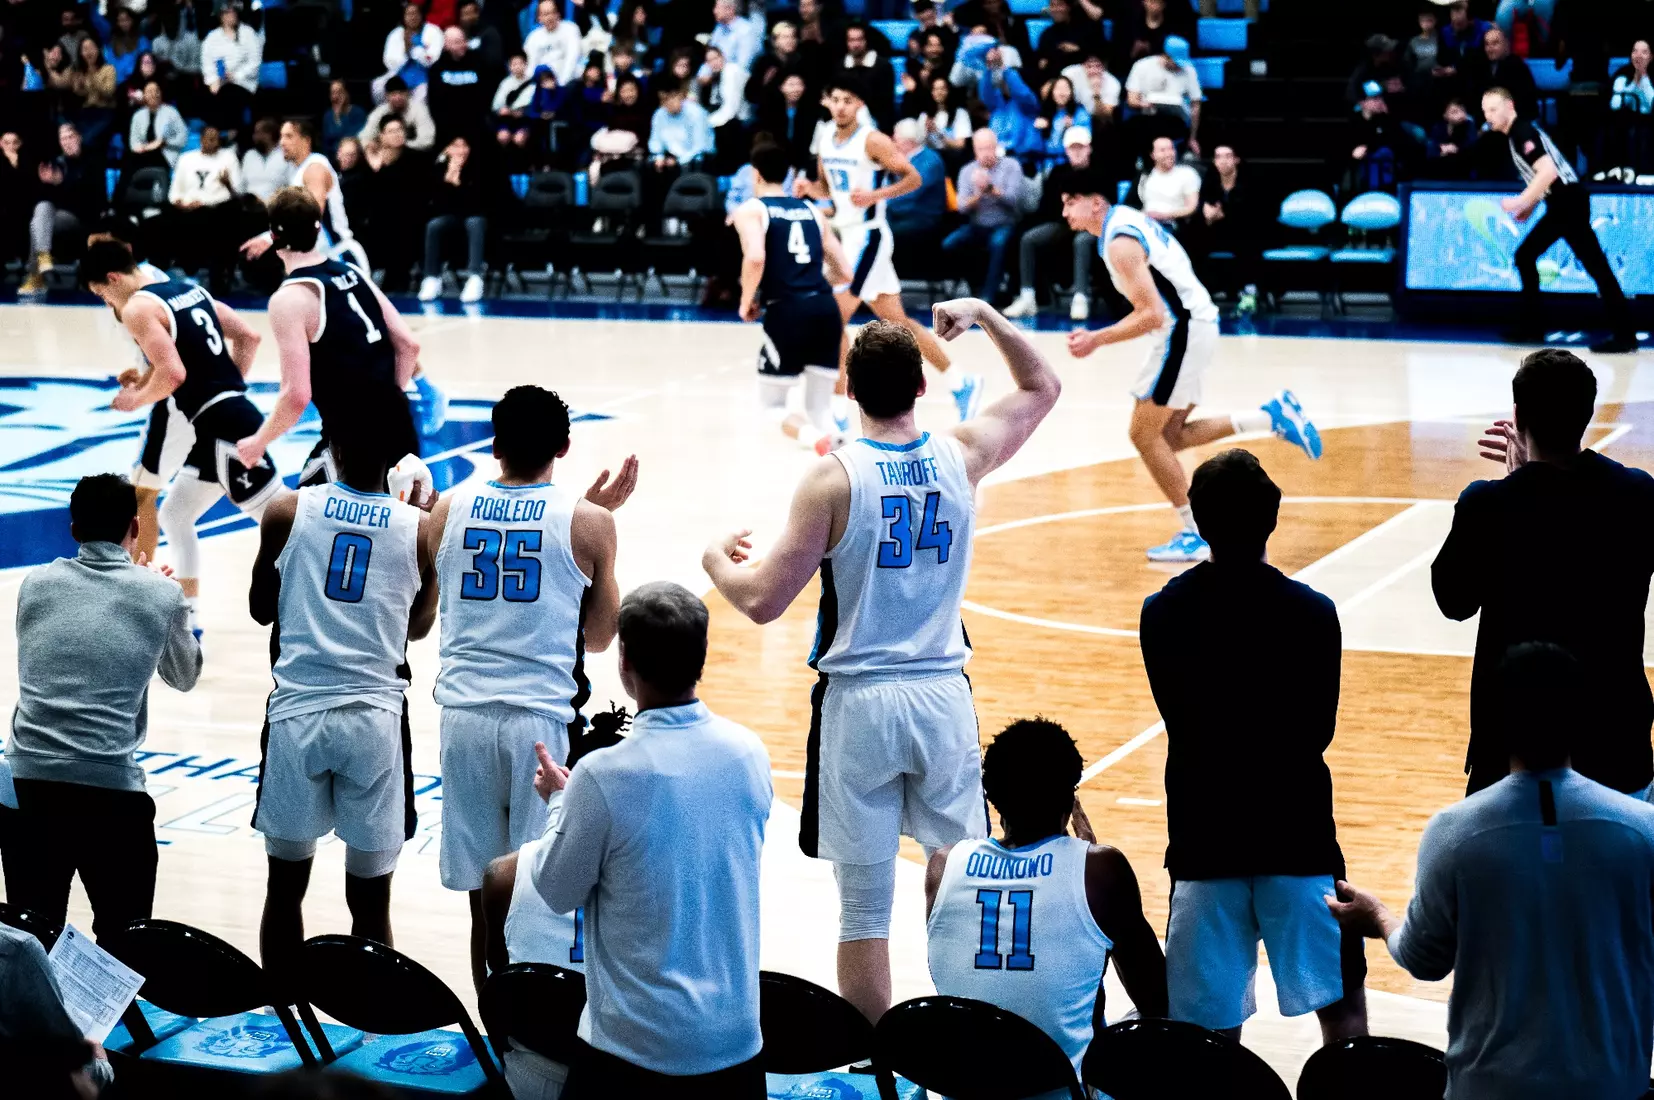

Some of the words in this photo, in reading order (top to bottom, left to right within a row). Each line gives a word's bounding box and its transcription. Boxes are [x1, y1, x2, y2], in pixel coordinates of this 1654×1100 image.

[196, 171, 210, 189] Y
[787, 220, 812, 264] 4
[190, 307, 223, 356] 3
[347, 292, 382, 344] 1
[324, 496, 391, 528] COOPER
[470, 495, 546, 522] ROBLEDO
[877, 491, 952, 568] 34
[324, 532, 373, 604] 0
[460, 527, 543, 603] 35
[966, 852, 1054, 880] ODUNOWO
[974, 888, 1035, 971] 11
